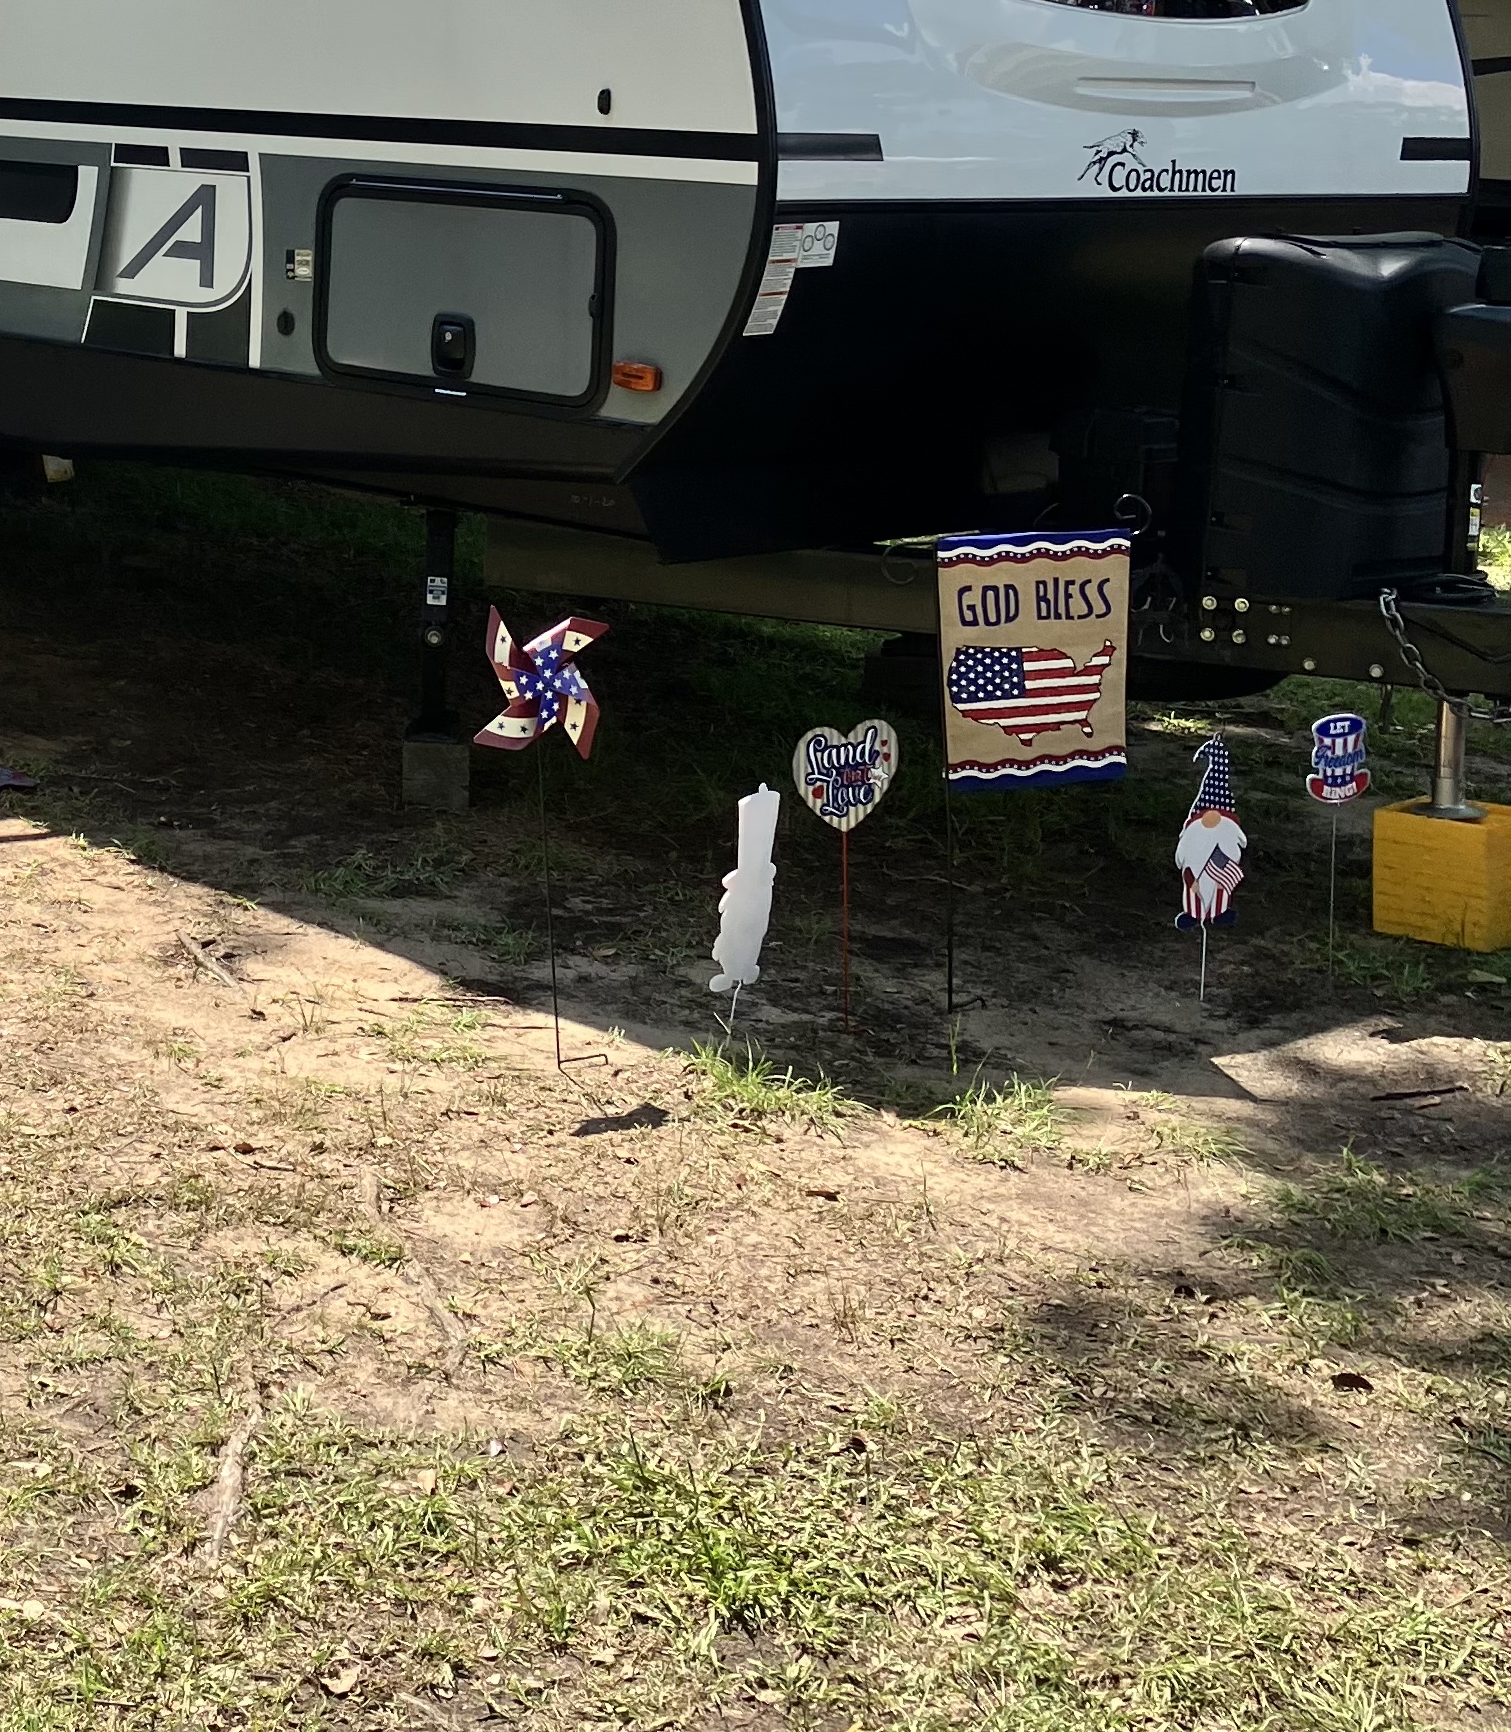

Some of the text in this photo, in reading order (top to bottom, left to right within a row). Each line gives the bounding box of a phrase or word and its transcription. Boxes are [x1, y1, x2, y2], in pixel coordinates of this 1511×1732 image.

[1107, 159, 1236, 193] Coachmen
[115, 183, 217, 289] A
[957, 576, 1112, 627] GOD BLESS
[1329, 720, 1351, 734] LET
[806, 727, 879, 784] Land
[821, 768, 874, 817] Love
